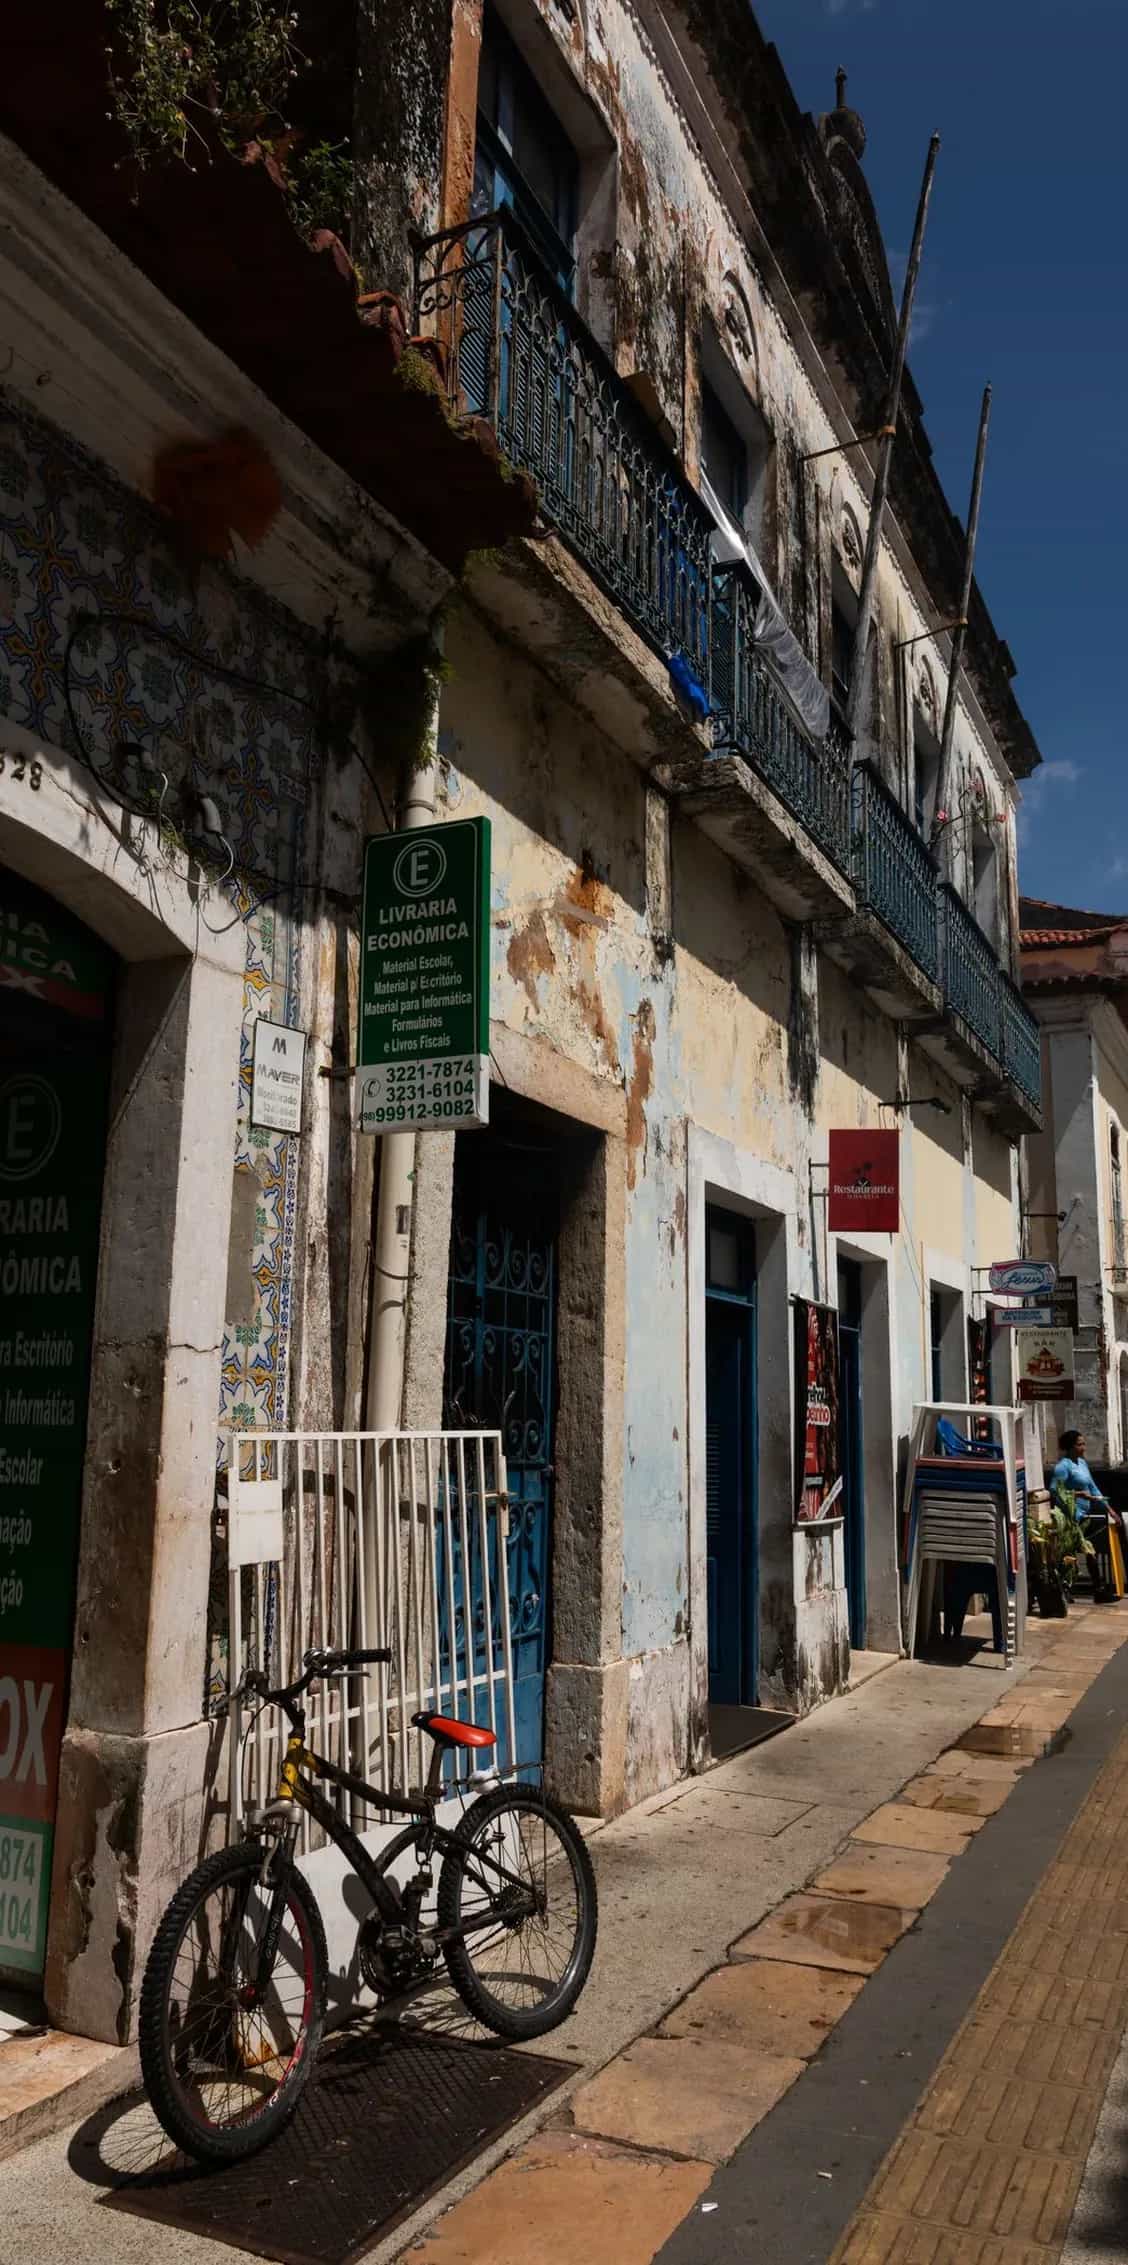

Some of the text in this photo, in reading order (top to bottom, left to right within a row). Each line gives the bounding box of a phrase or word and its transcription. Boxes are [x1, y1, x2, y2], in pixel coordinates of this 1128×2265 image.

[378, 897, 458, 926] LIVRARIA
[367, 921, 470, 952] ECONÔMICA
[382, 953, 454, 975] Material Escolar,
[374, 978, 409, 996] Material
[364, 992, 473, 1017] Material para Informática
[392, 1014, 443, 1032] Formulários
[384, 1033, 451, 1053] e Livros Fiscais
[386, 1060, 475, 1083] 3221-7874
[386, 1079, 475, 1103] 3231-6104
[375, 1099, 475, 1122] 99912-9082
[833, 1183, 895, 1195] Restaurante
[15, 1330, 73, 1368] Escritório
